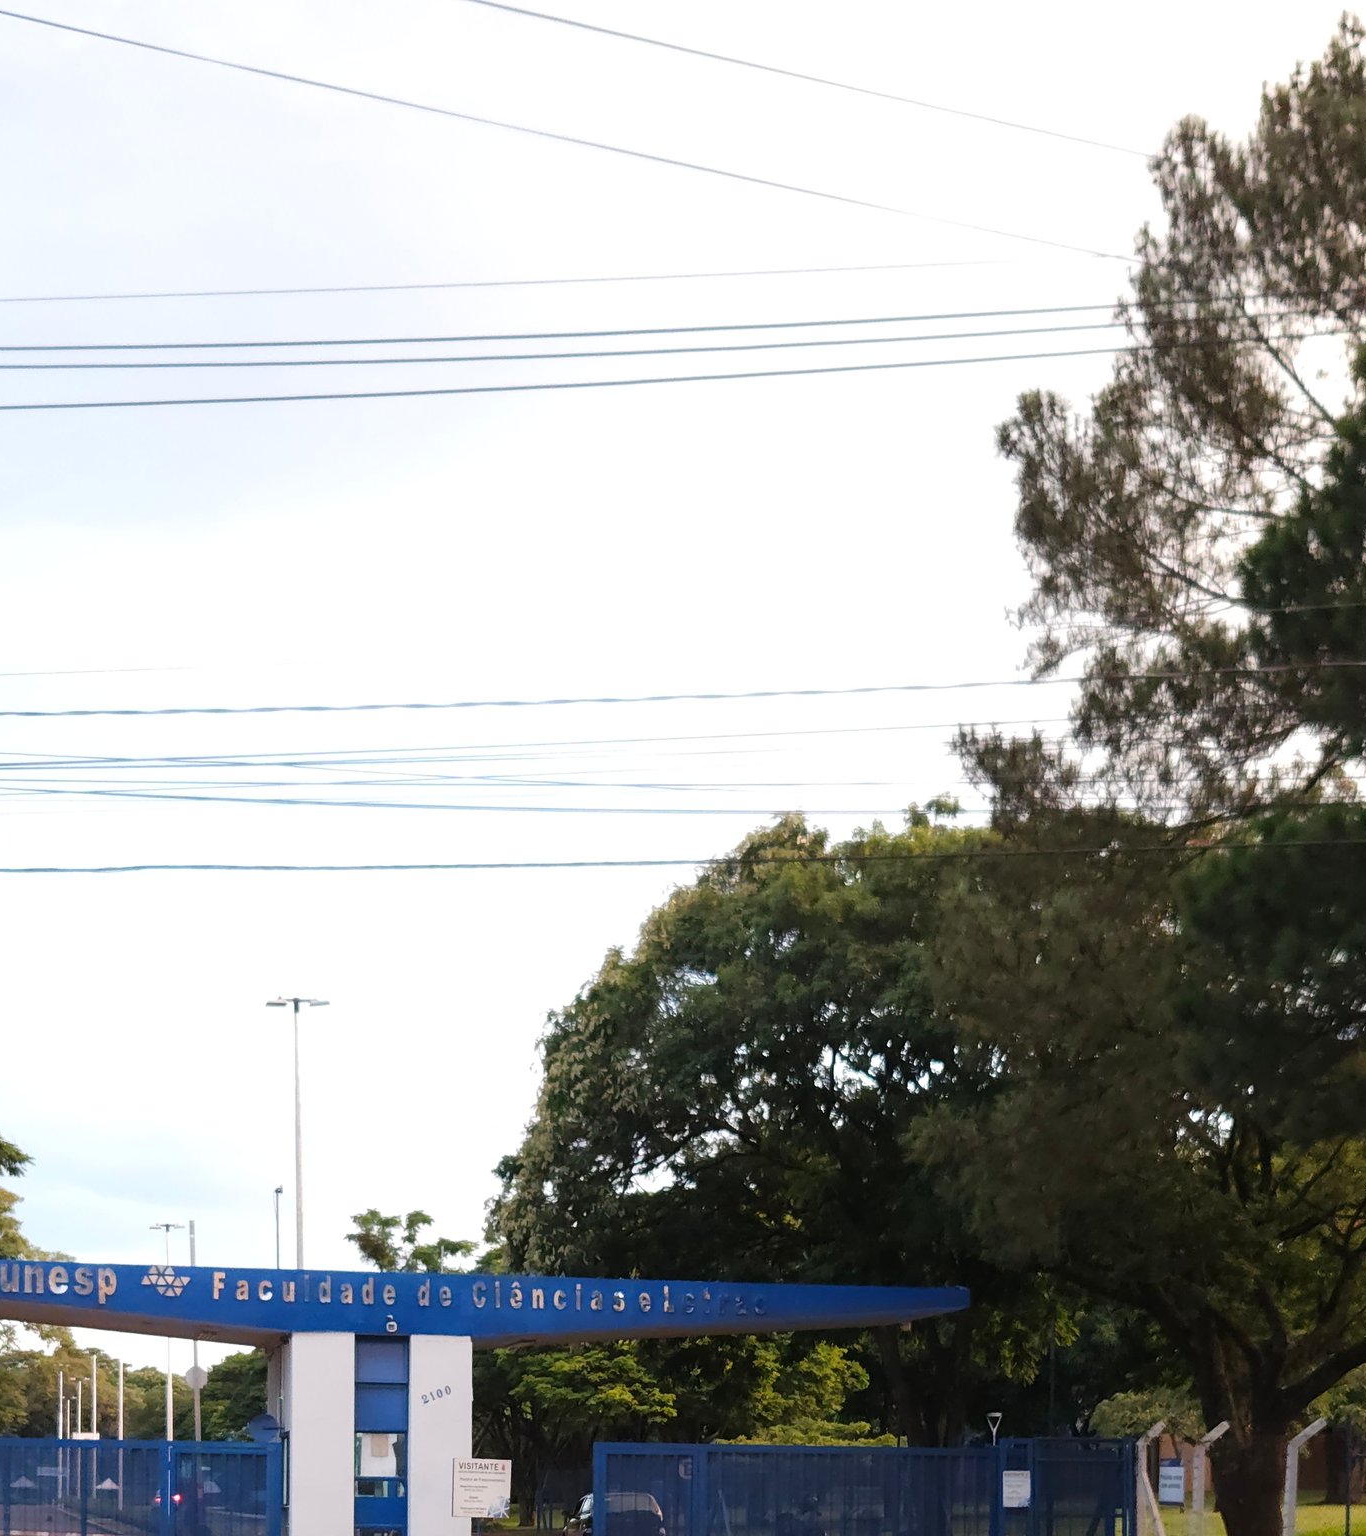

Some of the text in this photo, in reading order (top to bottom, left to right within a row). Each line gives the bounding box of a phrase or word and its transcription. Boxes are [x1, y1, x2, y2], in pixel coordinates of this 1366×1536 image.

[0, 1262, 117, 1304] unesp
[212, 1271, 397, 1306] Faculdade
[418, 1278, 453, 1307] de
[472, 1280, 626, 1313] Ciências
[638, 1291, 653, 1313] e
[421, 1385, 452, 1404] 2100
[458, 1462, 499, 1471] VISITANTE
